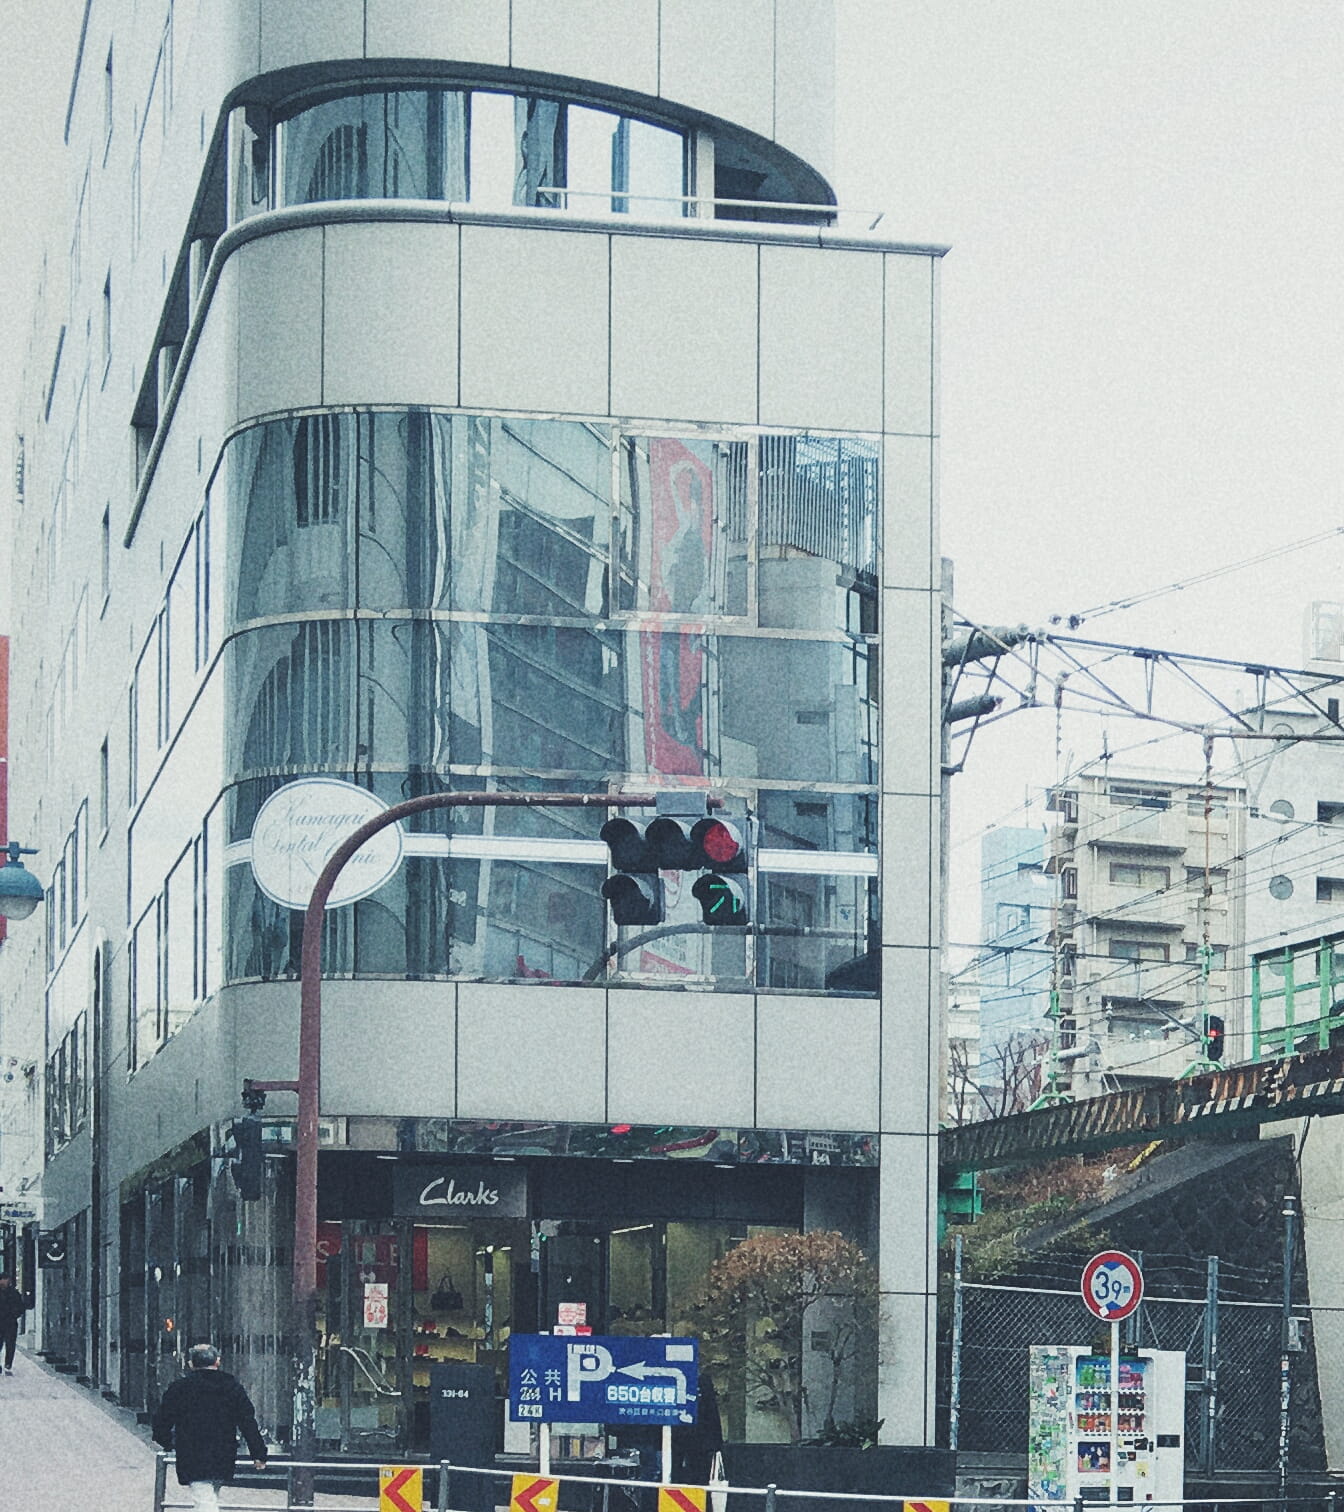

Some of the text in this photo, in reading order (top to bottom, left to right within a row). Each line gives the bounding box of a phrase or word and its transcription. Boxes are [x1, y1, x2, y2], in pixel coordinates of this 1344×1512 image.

[419, 1177, 499, 1205] Clarks
[520, 1369, 561, 1385] 公共
[567, 1343, 613, 1402] P
